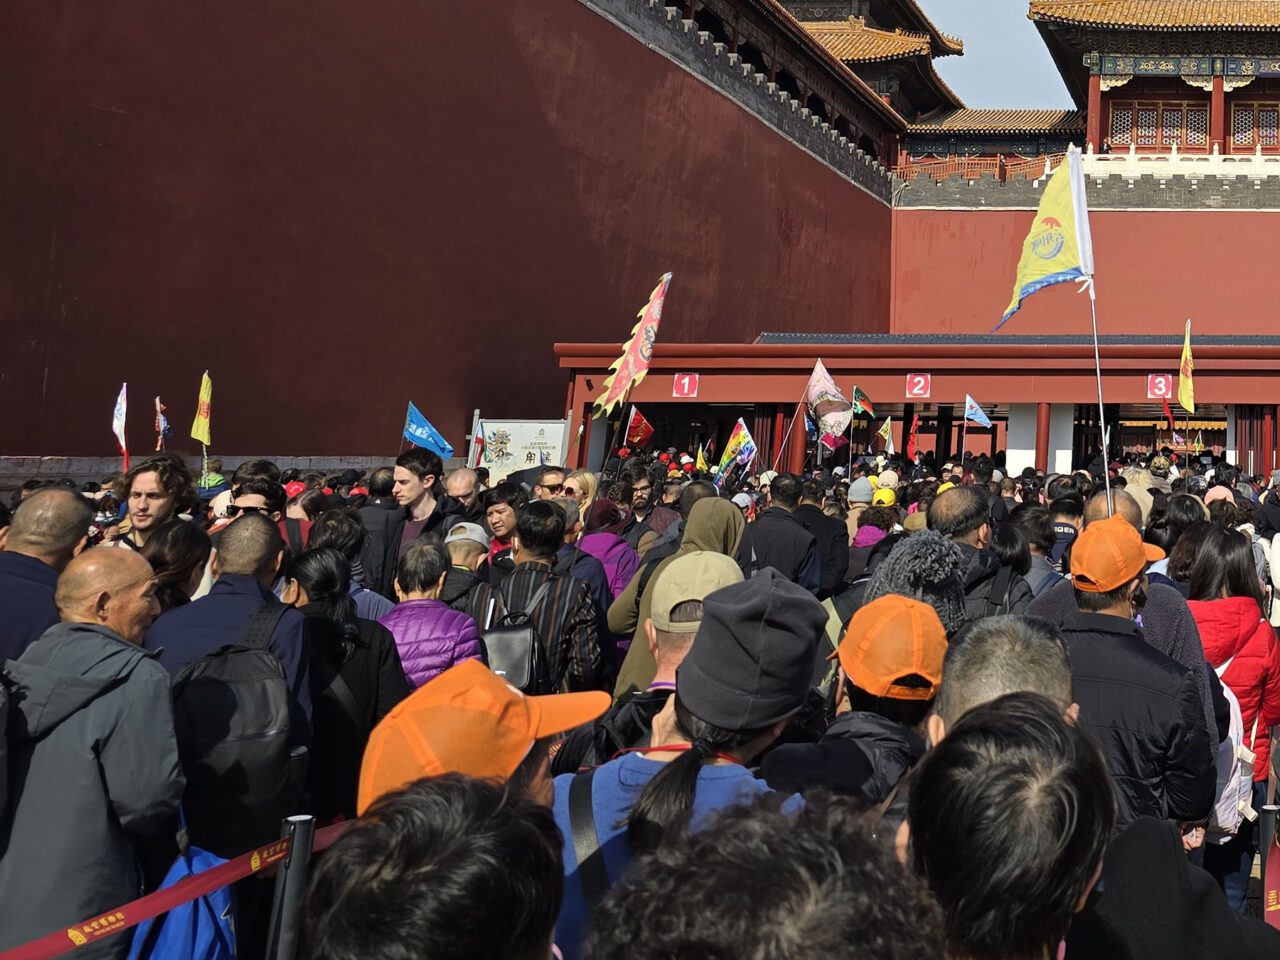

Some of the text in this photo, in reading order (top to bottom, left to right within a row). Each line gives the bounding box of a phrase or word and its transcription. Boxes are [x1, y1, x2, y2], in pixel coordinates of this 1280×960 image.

[681, 375, 690, 394] 1
[912, 376, 925, 394] 2
[1154, 377, 1166, 395] 3
